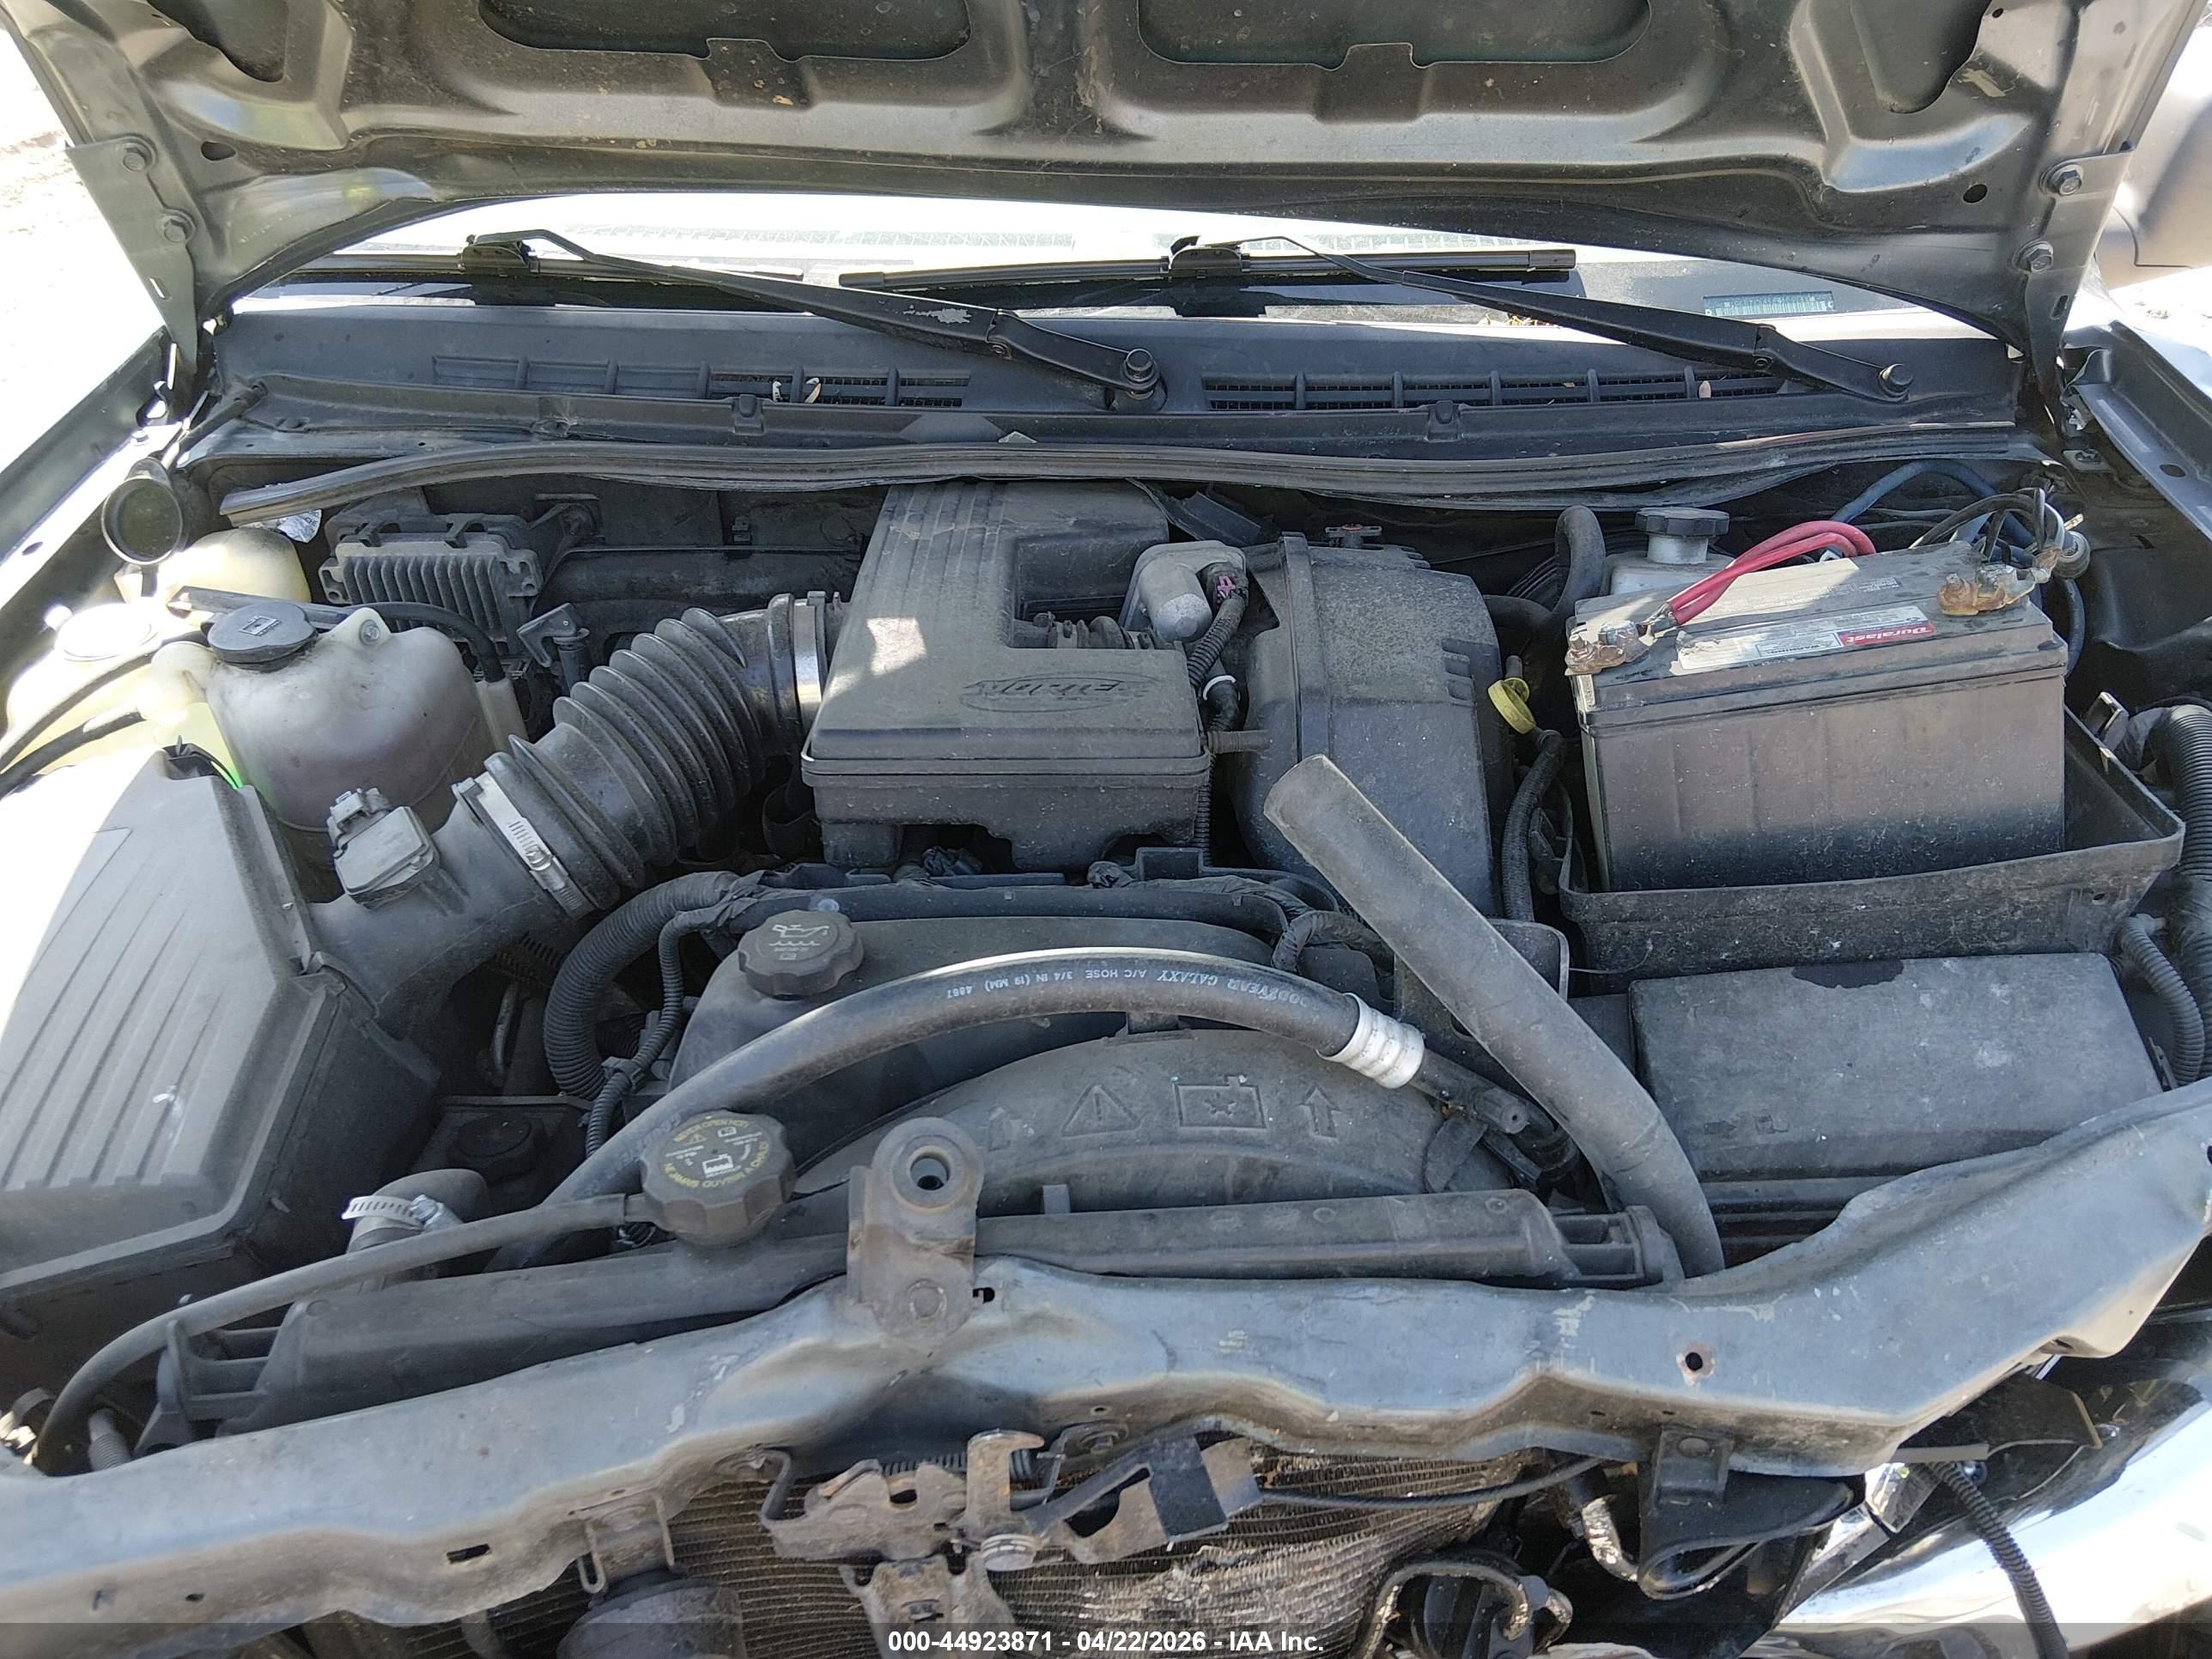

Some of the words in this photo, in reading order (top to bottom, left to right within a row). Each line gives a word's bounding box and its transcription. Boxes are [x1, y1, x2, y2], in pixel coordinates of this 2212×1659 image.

[1845, 627, 1930, 642] Duralast
[1036, 973, 1048, 982] IN
[1054, 970, 1073, 981] 3/4
[1085, 969, 1118, 979] HOSE
[1124, 969, 1146, 978] A/C
[1157, 969, 1218, 987] GALAXY
[984, 977, 1009, 993] MM)
[1013, 974, 1030, 987] (19
[1227, 977, 1314, 1008] OODYEAR
